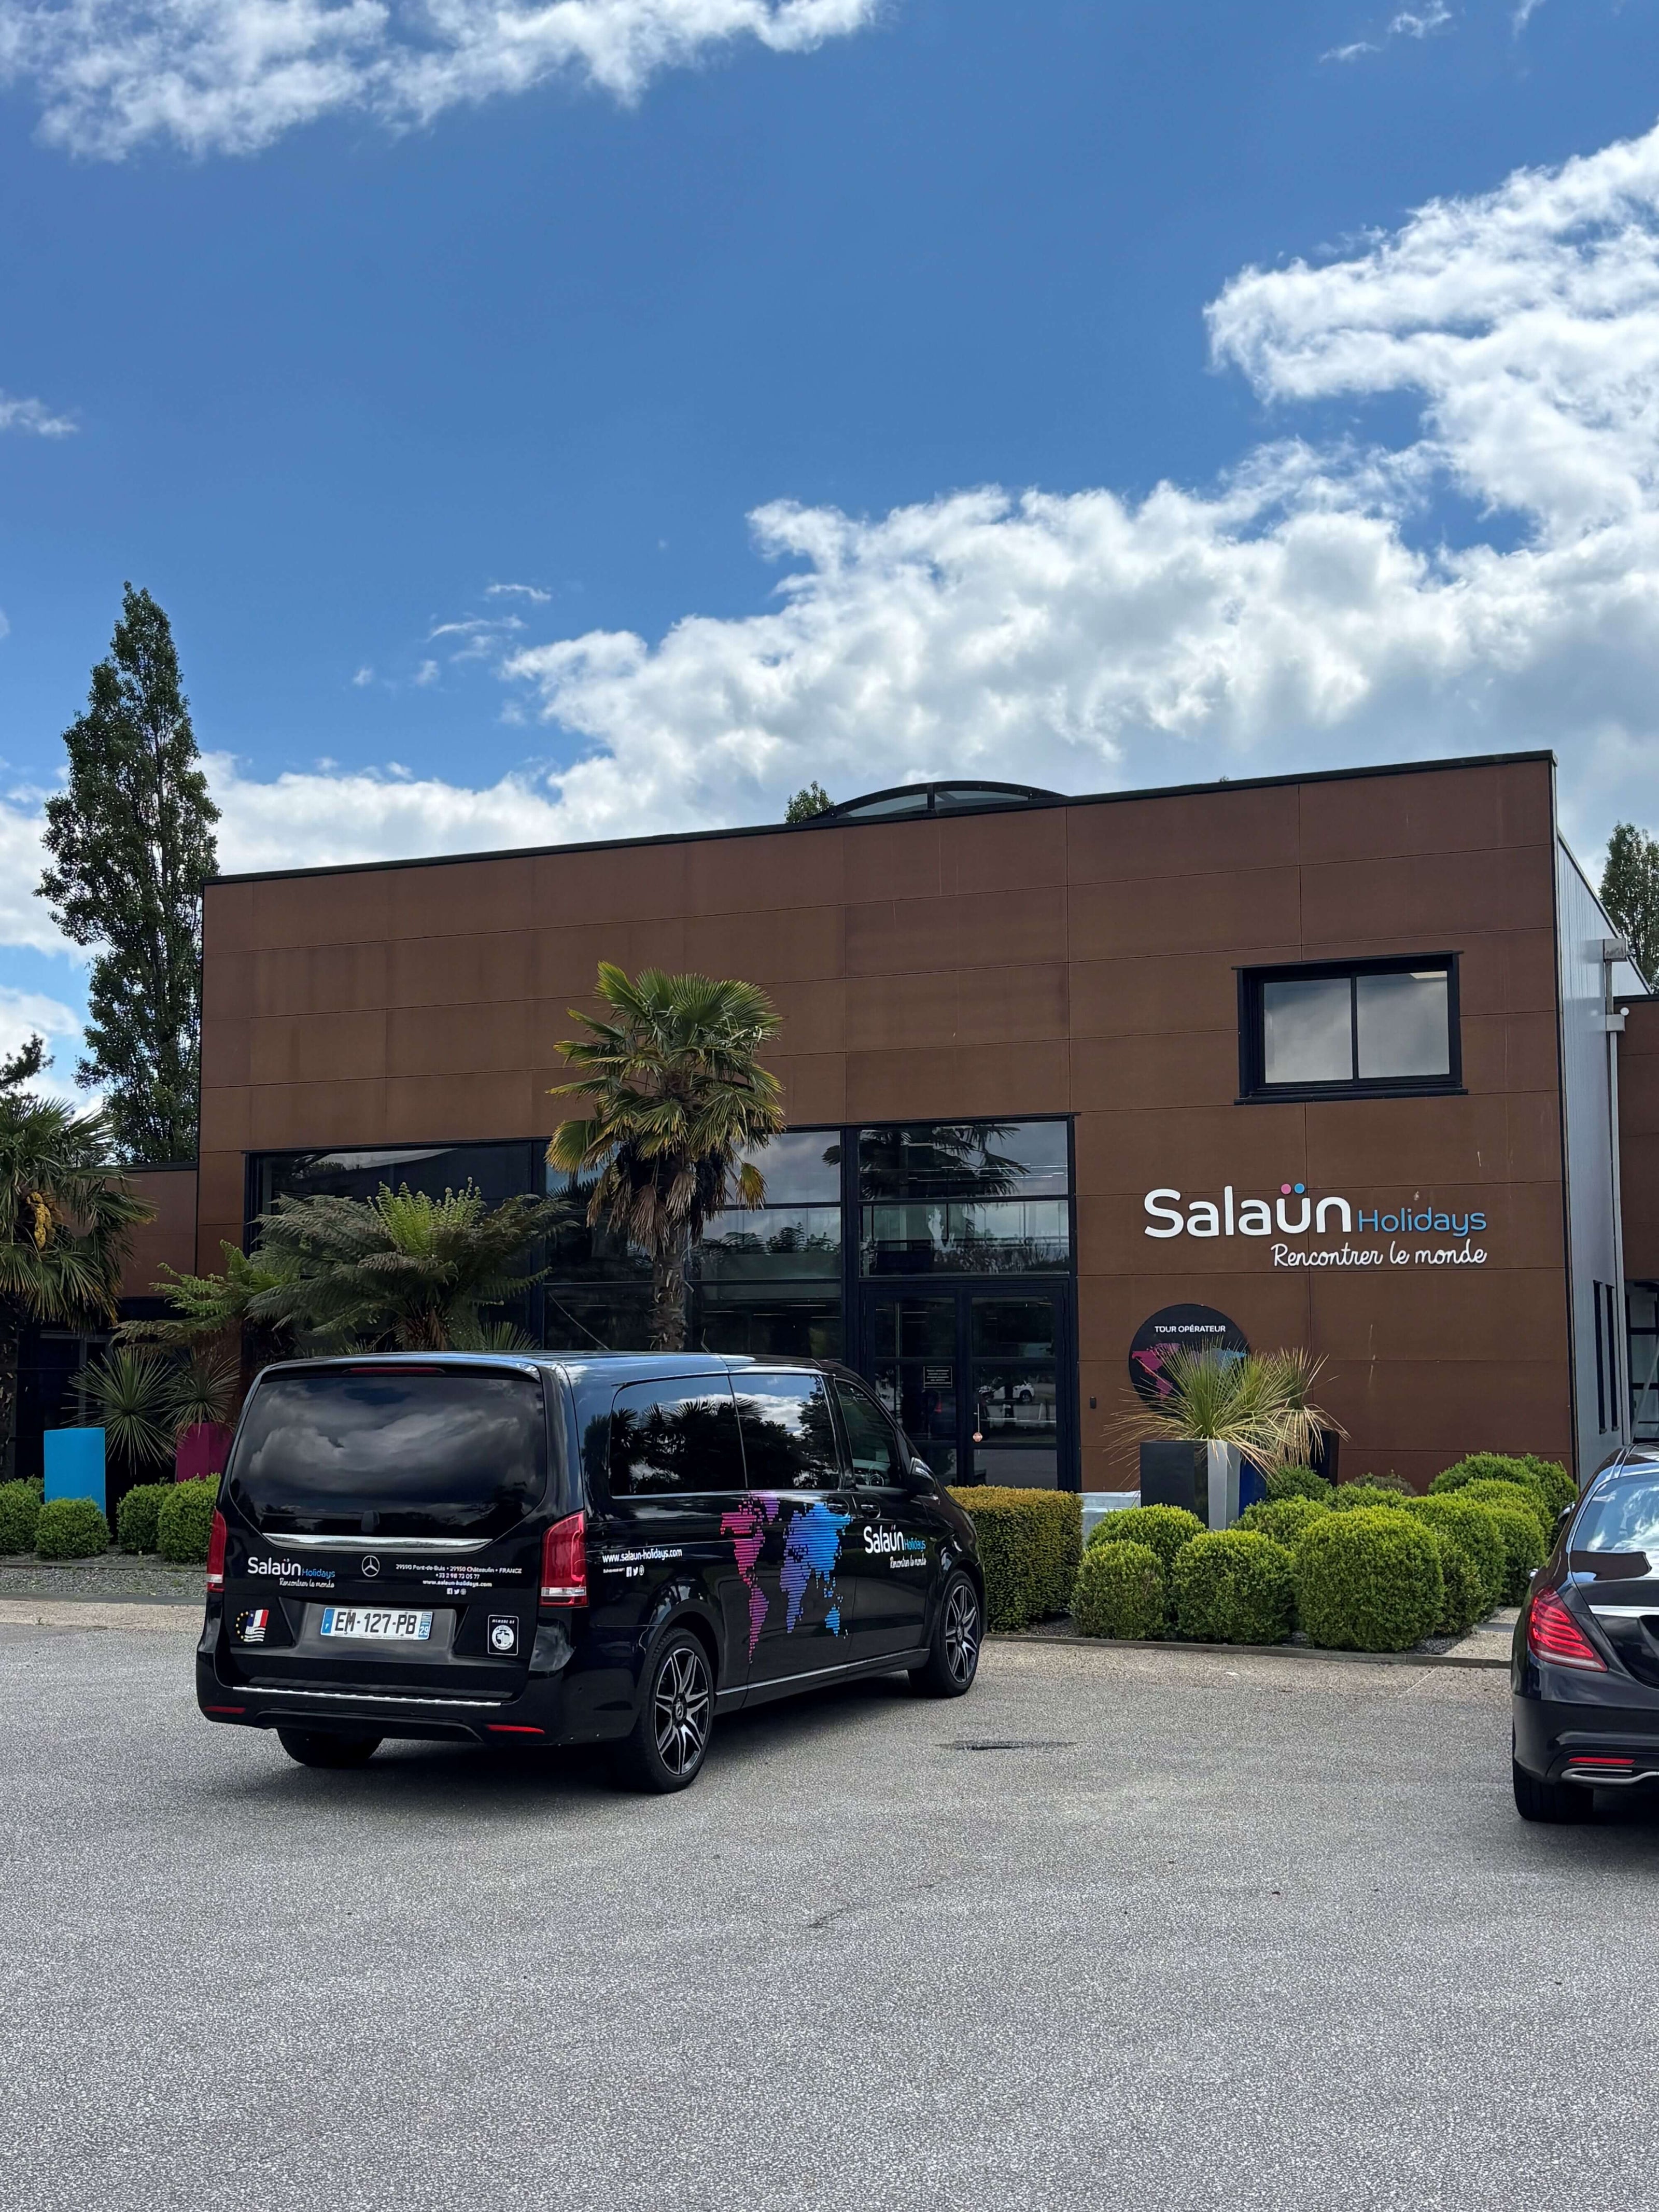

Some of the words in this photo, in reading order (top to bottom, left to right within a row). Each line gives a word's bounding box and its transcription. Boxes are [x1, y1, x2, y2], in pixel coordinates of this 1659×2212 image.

[1144, 1183, 1352, 1238] Salaün
[1358, 1207, 1487, 1237] Holidays
[1270, 1242, 1384, 1267] Rencontrer
[1389, 1240, 1410, 1265] le
[1414, 1238, 1488, 1265] monde
[1178, 1324, 1226, 1333] OPÉRATEUR
[863, 1524, 905, 1553] Salaün
[602, 1548, 682, 1563] www.salaun-holidays.com
[247, 1557, 301, 1576] Salaün
[302, 1568, 335, 1579] Holidays
[334, 1611, 417, 1634] EM-127-PB
[420, 1626, 429, 1636] 29
